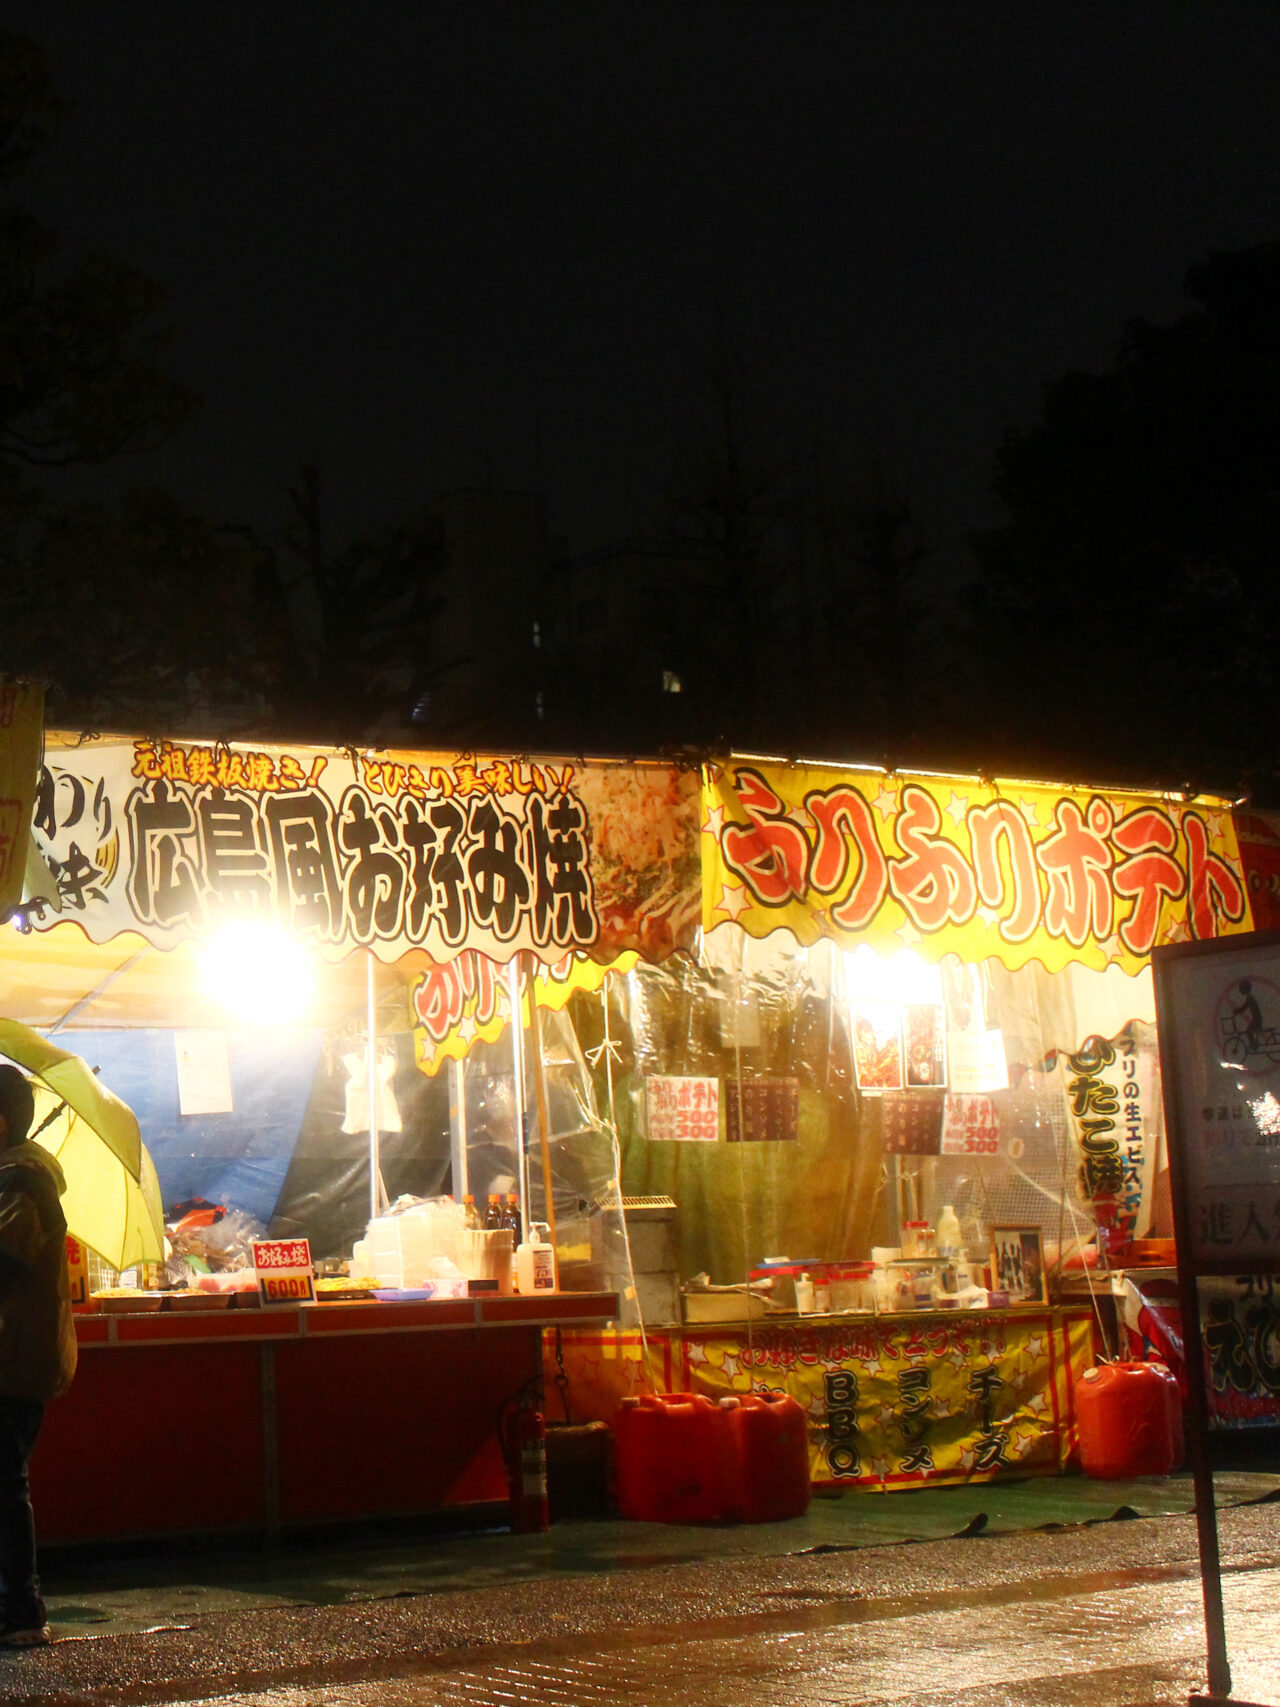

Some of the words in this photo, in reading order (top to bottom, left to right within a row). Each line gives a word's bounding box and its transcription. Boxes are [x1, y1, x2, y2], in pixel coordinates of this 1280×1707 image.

[131, 740, 328, 792] 元祖鉄板焼き!
[124, 778, 599, 946] 広島風お好み焼
[676, 1125, 717, 1138] 300
[677, 1111, 717, 1124] 500
[966, 1127, 999, 1139] 500
[965, 1139, 998, 1152] 300
[1200, 1199, 1280, 1245] 進入
[258, 1244, 307, 1266] お好み焼
[267, 1279, 307, 1298] 600円
[823, 1369, 862, 1478] BBQ
[897, 1366, 934, 1473] コンソメ
[967, 1365, 1011, 1471] チーズ
